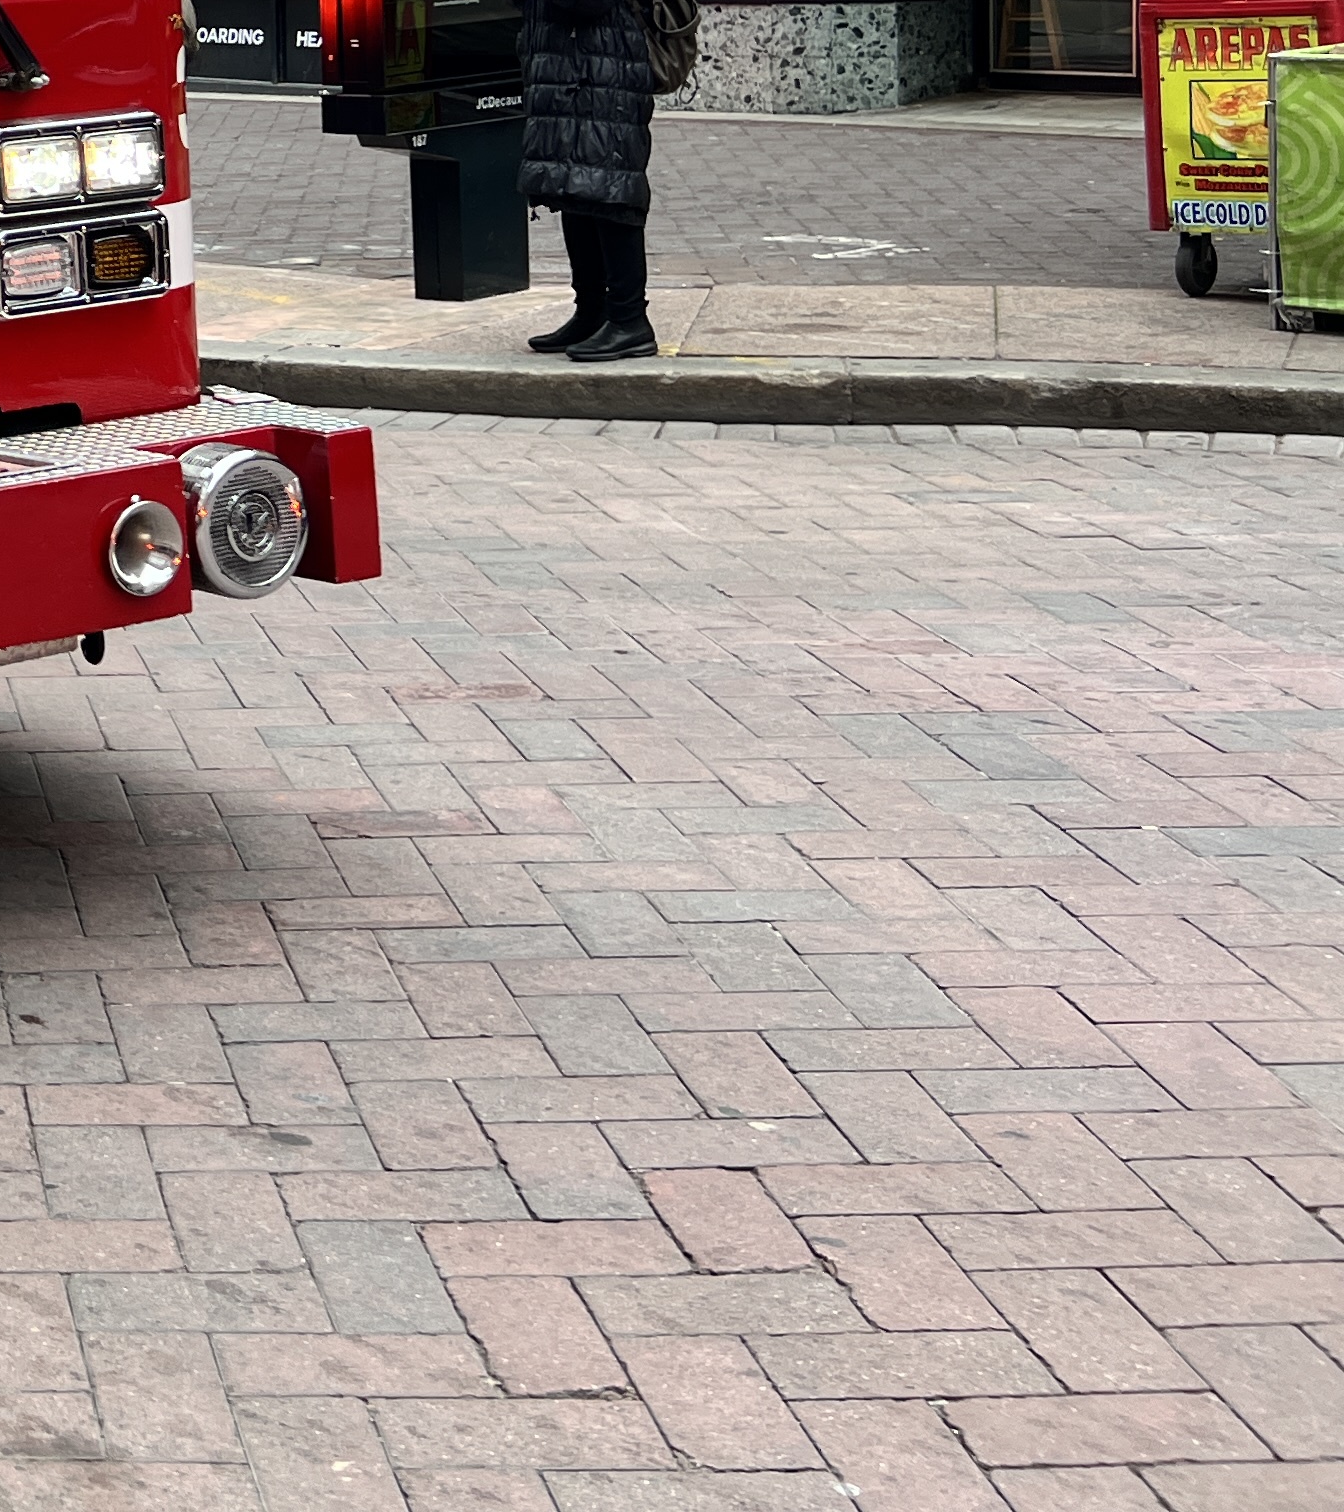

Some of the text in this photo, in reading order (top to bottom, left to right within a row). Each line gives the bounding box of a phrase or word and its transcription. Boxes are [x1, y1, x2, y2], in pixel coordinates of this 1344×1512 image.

[196, 26, 265, 46] OARDING
[475, 95, 523, 110] JCDecaux
[1174, 202, 1268, 226] ICE COLD D
